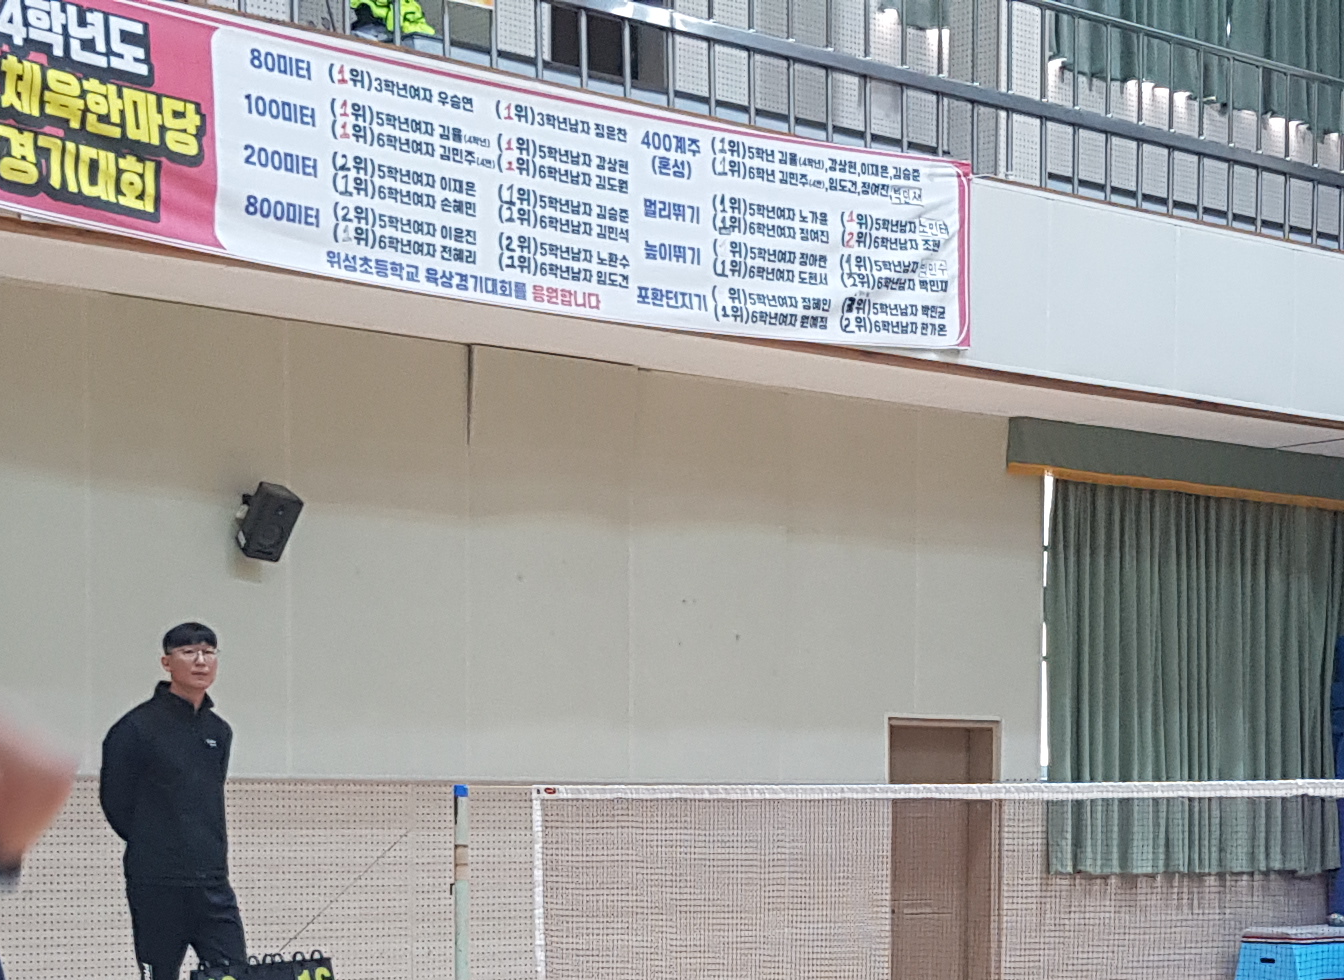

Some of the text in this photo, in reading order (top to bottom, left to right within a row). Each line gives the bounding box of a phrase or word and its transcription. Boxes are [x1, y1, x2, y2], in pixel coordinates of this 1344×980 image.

[250, 48, 312, 81] 80미터
[0, 54, 201, 156] 체육한마당
[244, 93, 317, 128] 100미터
[641, 130, 701, 157] 400계주
[243, 144, 318, 178] 200미터
[651, 155, 692, 180] (혼성)
[244, 194, 320, 228] 800미터
[644, 198, 700, 224] 멀리뛰기
[644, 240, 701, 265] 높이뛰기
[326, 250, 601, 310] 위성초등학교 육상경기대회를 응원합니다
[636, 286, 708, 312] 포환던지기
